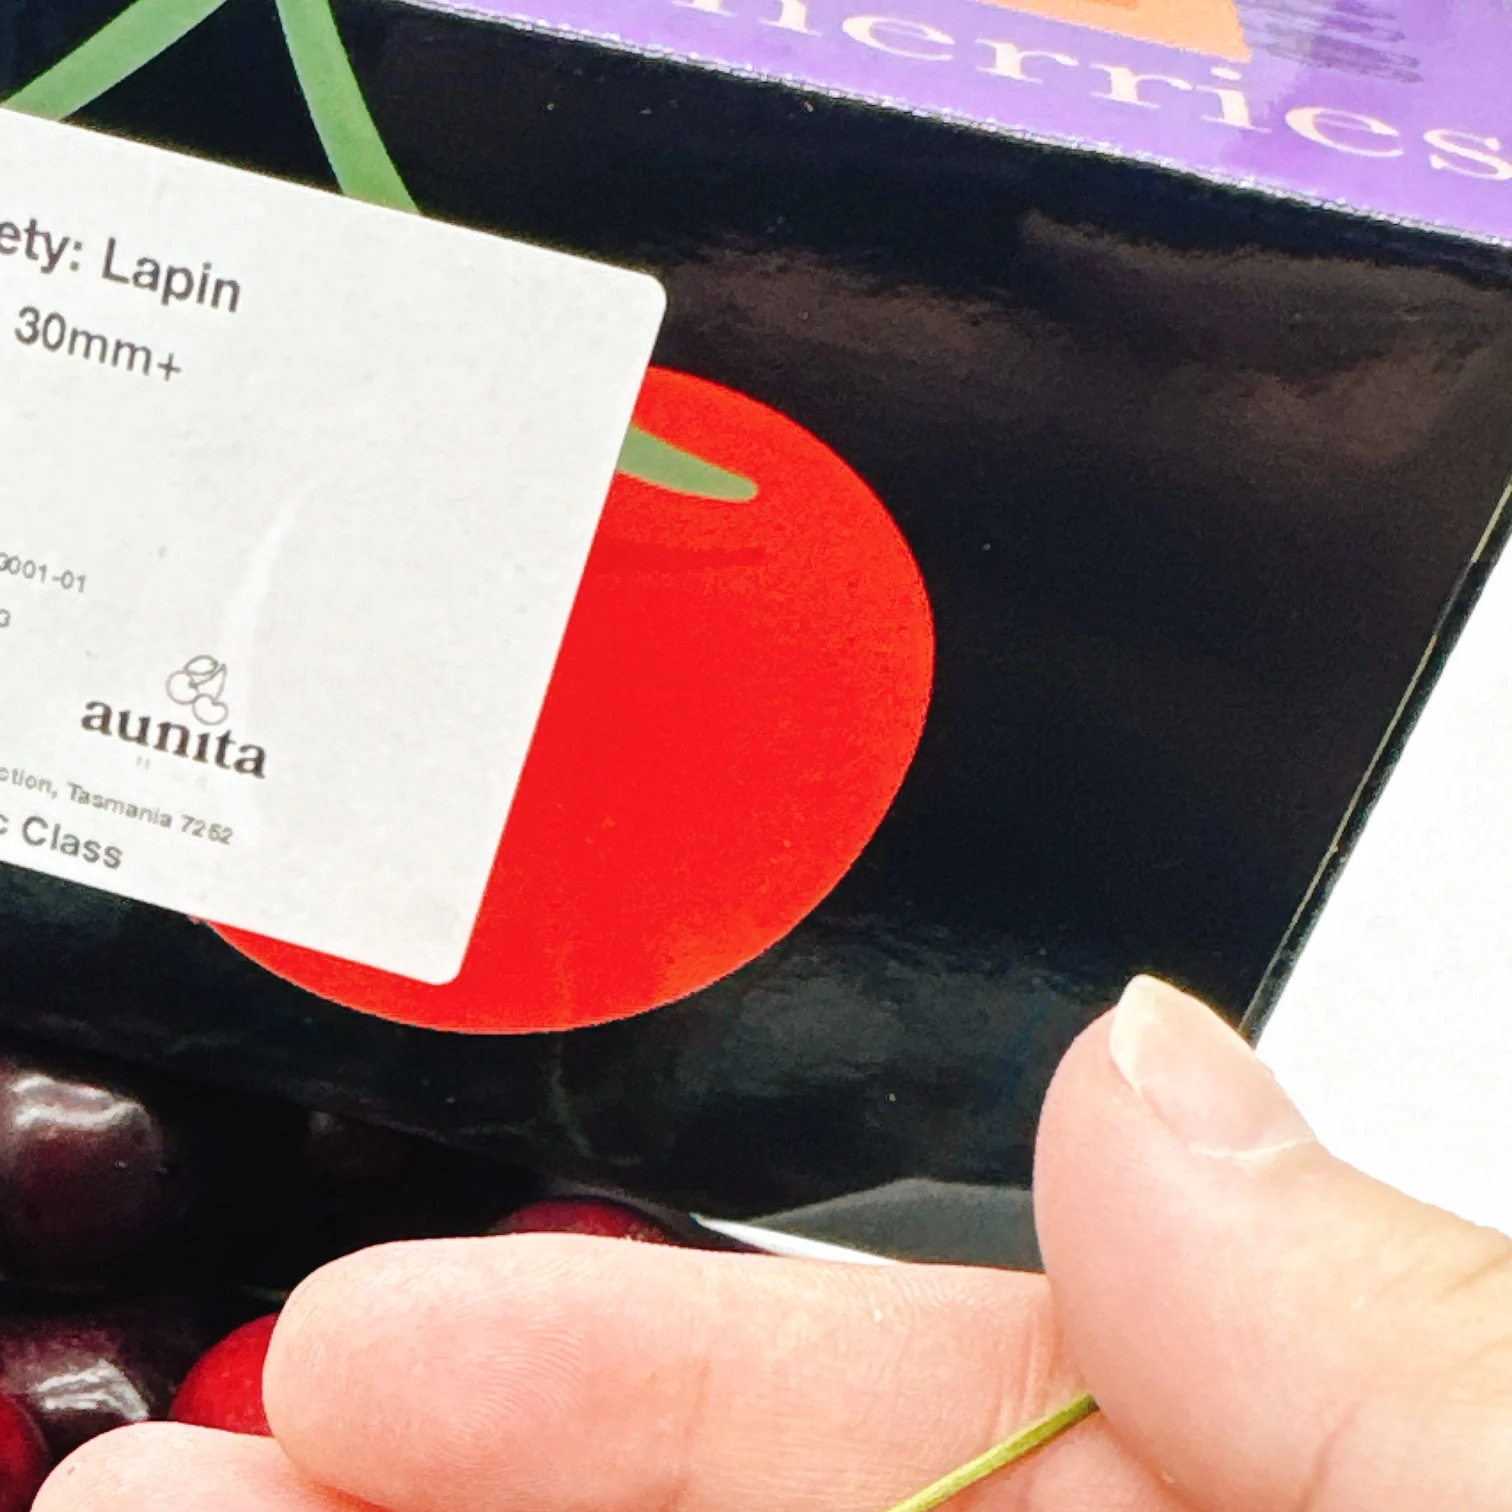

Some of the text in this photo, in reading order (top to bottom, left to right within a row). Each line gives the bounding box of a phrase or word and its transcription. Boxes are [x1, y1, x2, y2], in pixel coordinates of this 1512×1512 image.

[100, 236, 241, 314] Lapin
[13, 305, 182, 382] 30mm+
[80, 700, 267, 780] aunita
[20, 814, 124, 871] Class
[67, 781, 173, 829] Tasmania
